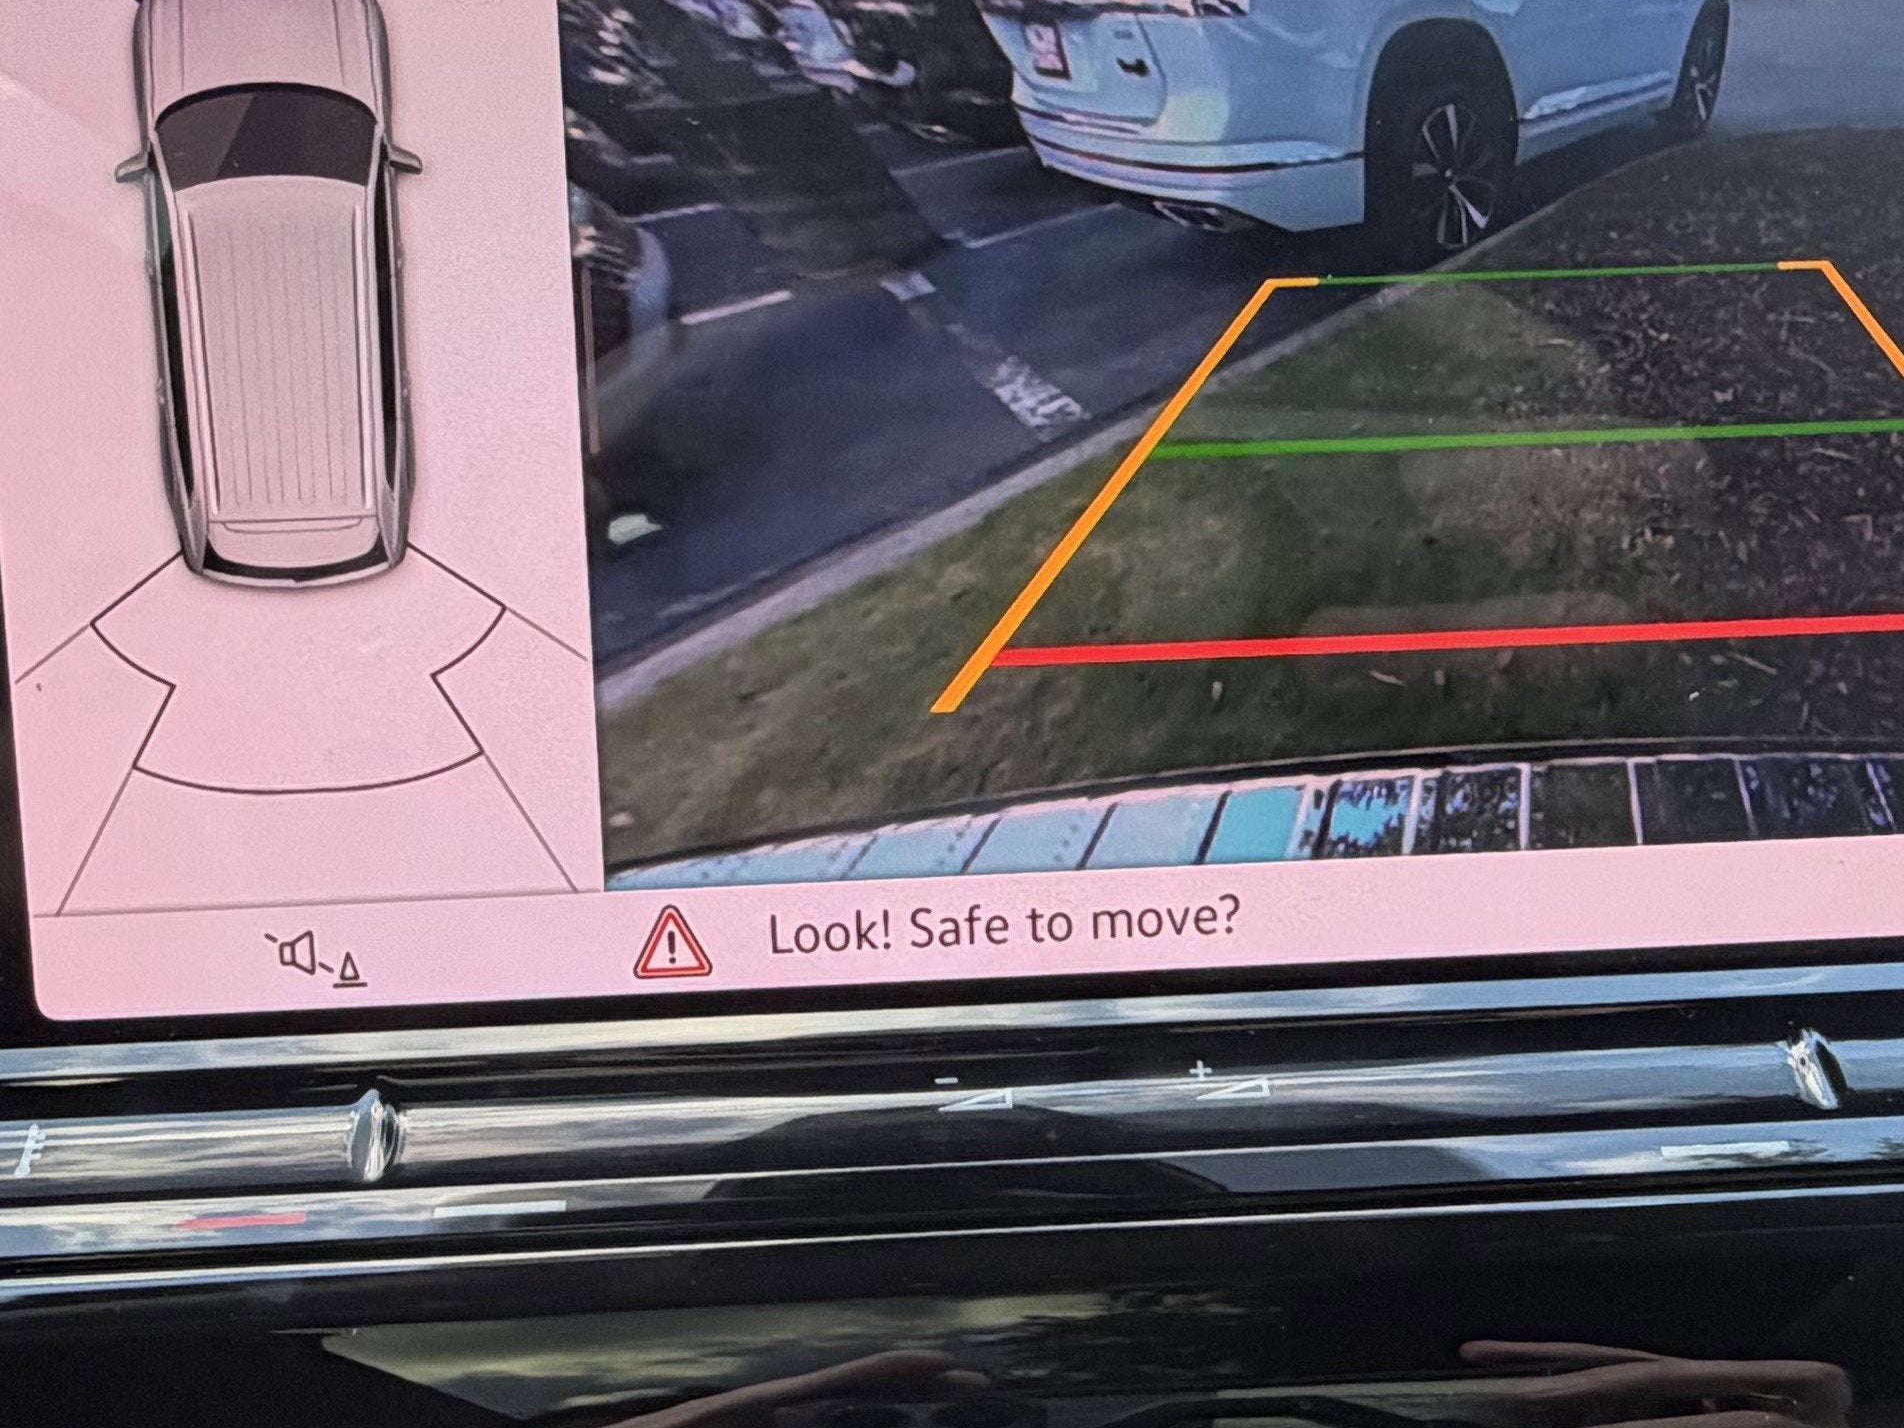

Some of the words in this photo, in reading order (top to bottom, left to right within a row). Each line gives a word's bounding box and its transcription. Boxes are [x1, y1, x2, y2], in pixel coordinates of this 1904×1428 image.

[770, 908, 892, 955] Look!
[910, 903, 1010, 949] Safe
[1026, 907, 1074, 943] to
[1092, 893, 1241, 941] move?
